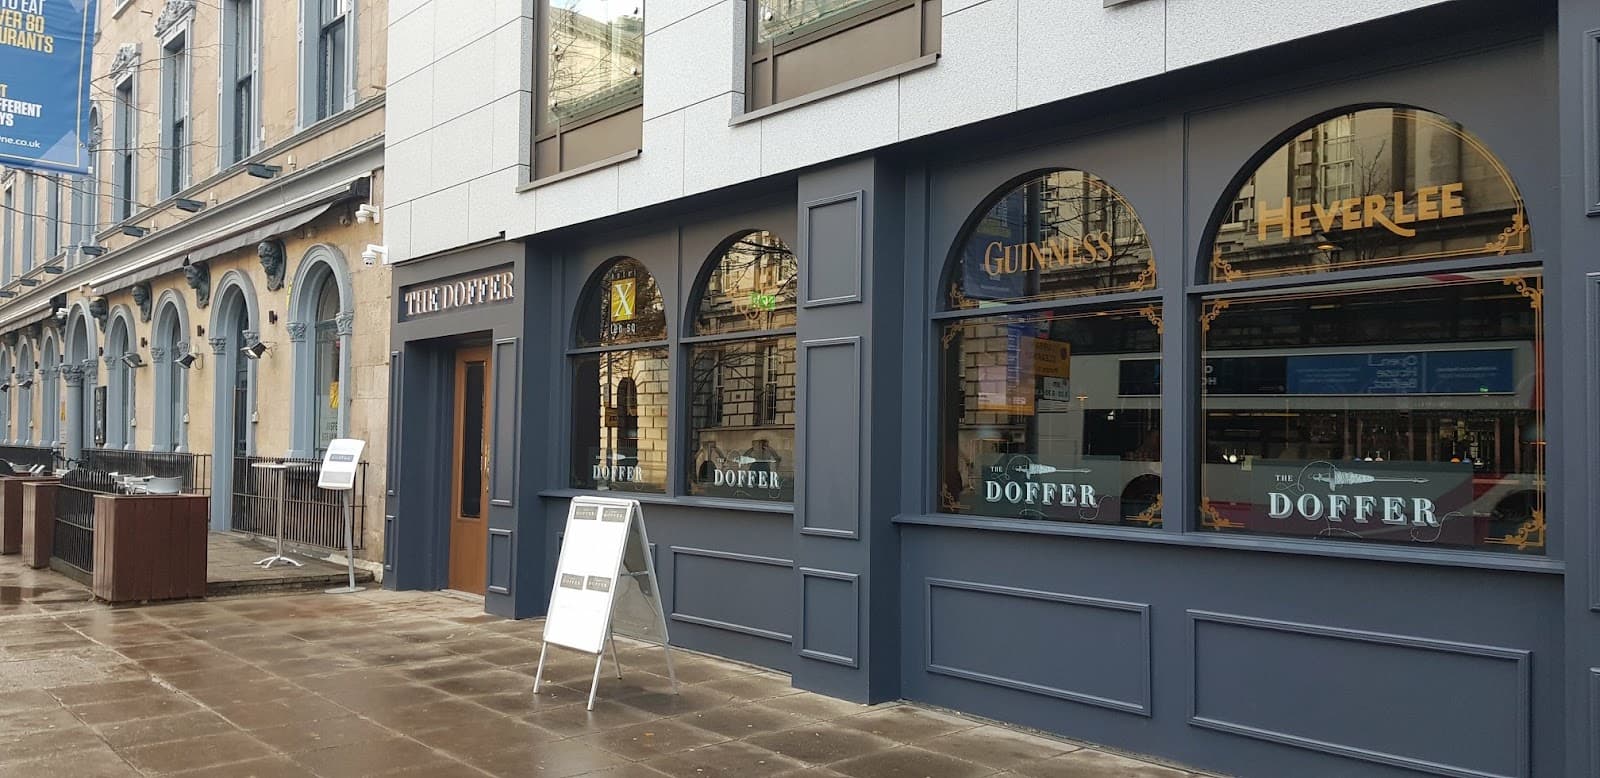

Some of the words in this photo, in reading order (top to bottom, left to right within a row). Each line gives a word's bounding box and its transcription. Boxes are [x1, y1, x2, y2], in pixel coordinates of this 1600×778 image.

[21, 0, 45, 15] EAT
[26, 14, 45, 33] 80
[0, 136, 41, 148] ne.co.uk
[1258, 183, 1464, 241] HEVERLEE
[984, 231, 1113, 276] GUINNESS
[404, 286, 440, 316] THE
[440, 271, 514, 310] DOFFER
[615, 283, 632, 316] X
[592, 464, 642, 481] DOFFER
[713, 469, 780, 489] DOFFER
[1275, 474, 1293, 482] THE
[985, 480, 1098, 508] DOFFER
[1267, 492, 1441, 527] DOFFER
